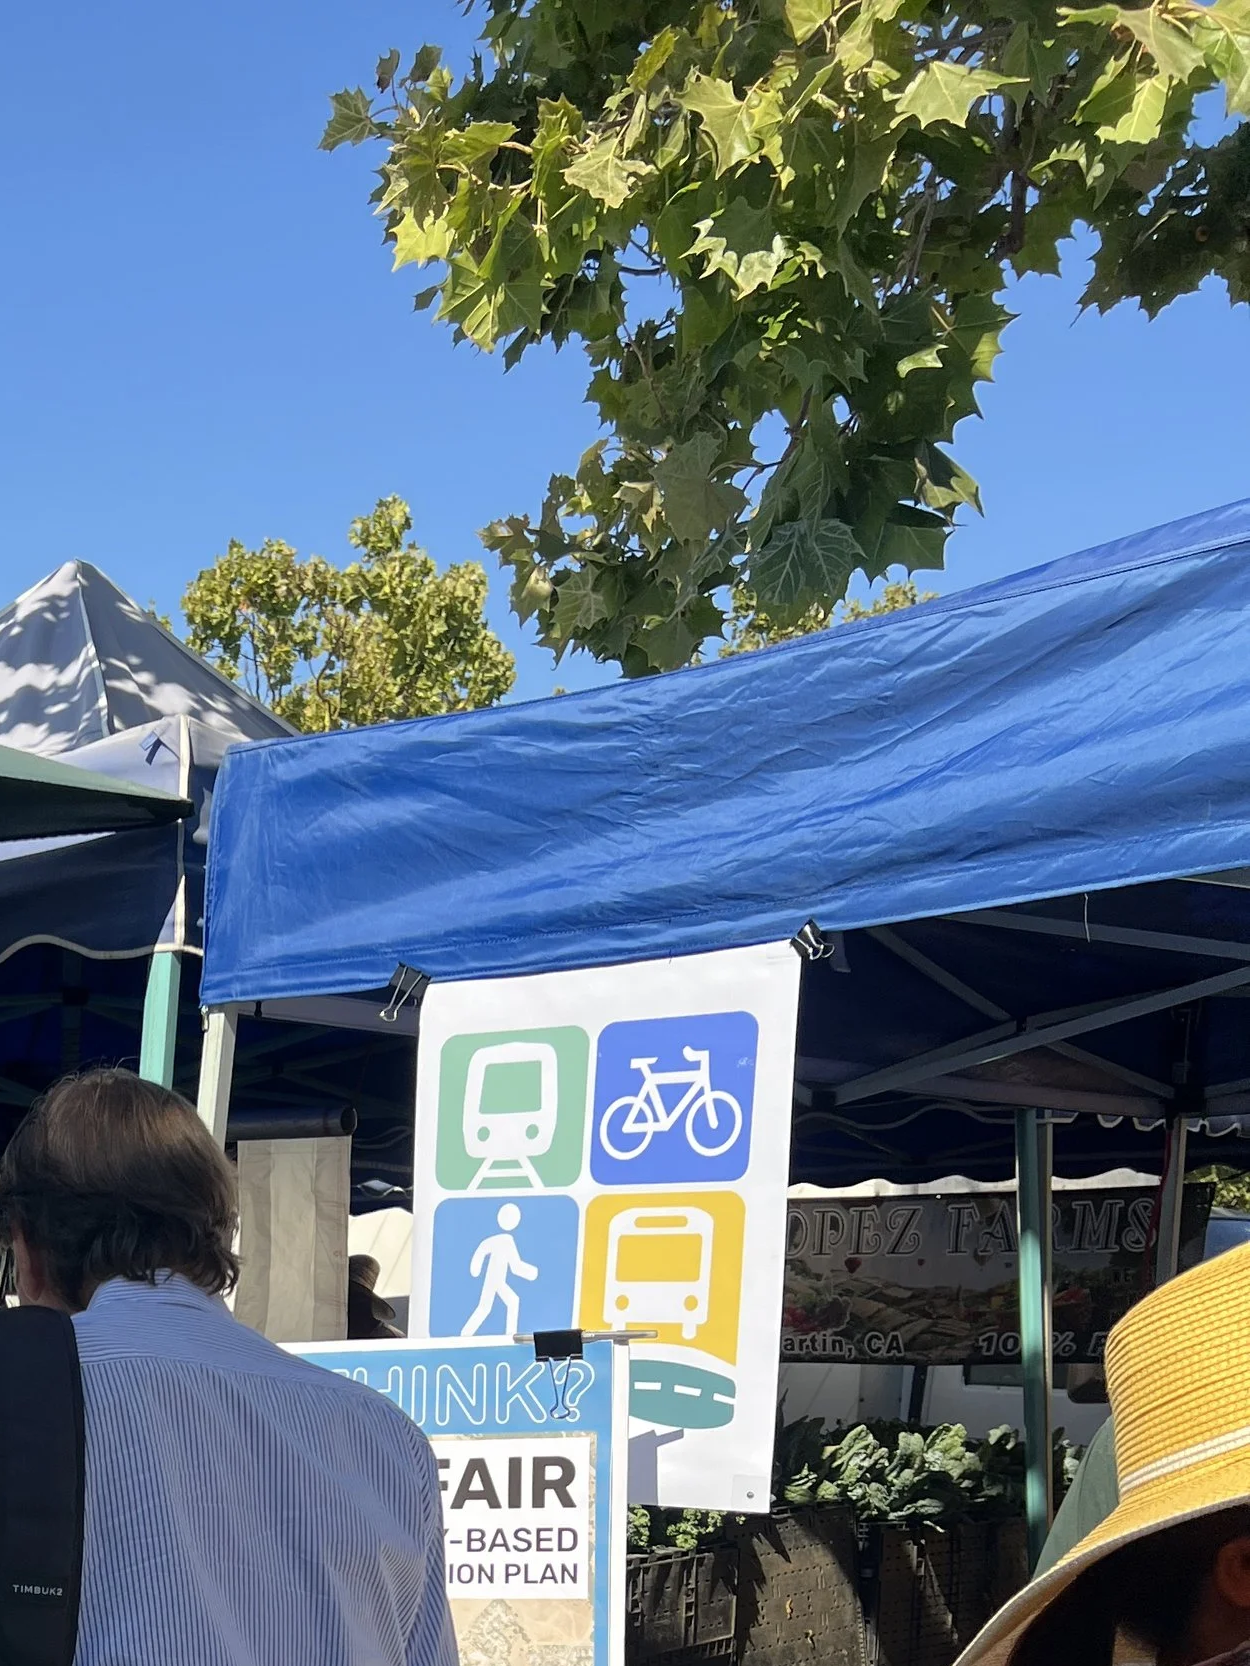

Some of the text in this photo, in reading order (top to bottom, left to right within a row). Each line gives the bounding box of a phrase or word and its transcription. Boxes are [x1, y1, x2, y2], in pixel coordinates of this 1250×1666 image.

[863, 1331, 906, 1357] CA
[330, 1360, 596, 1427] HINK?
[505, 1563, 578, 1585] PLAN
[12, 1584, 63, 1596] TIMBUK2
